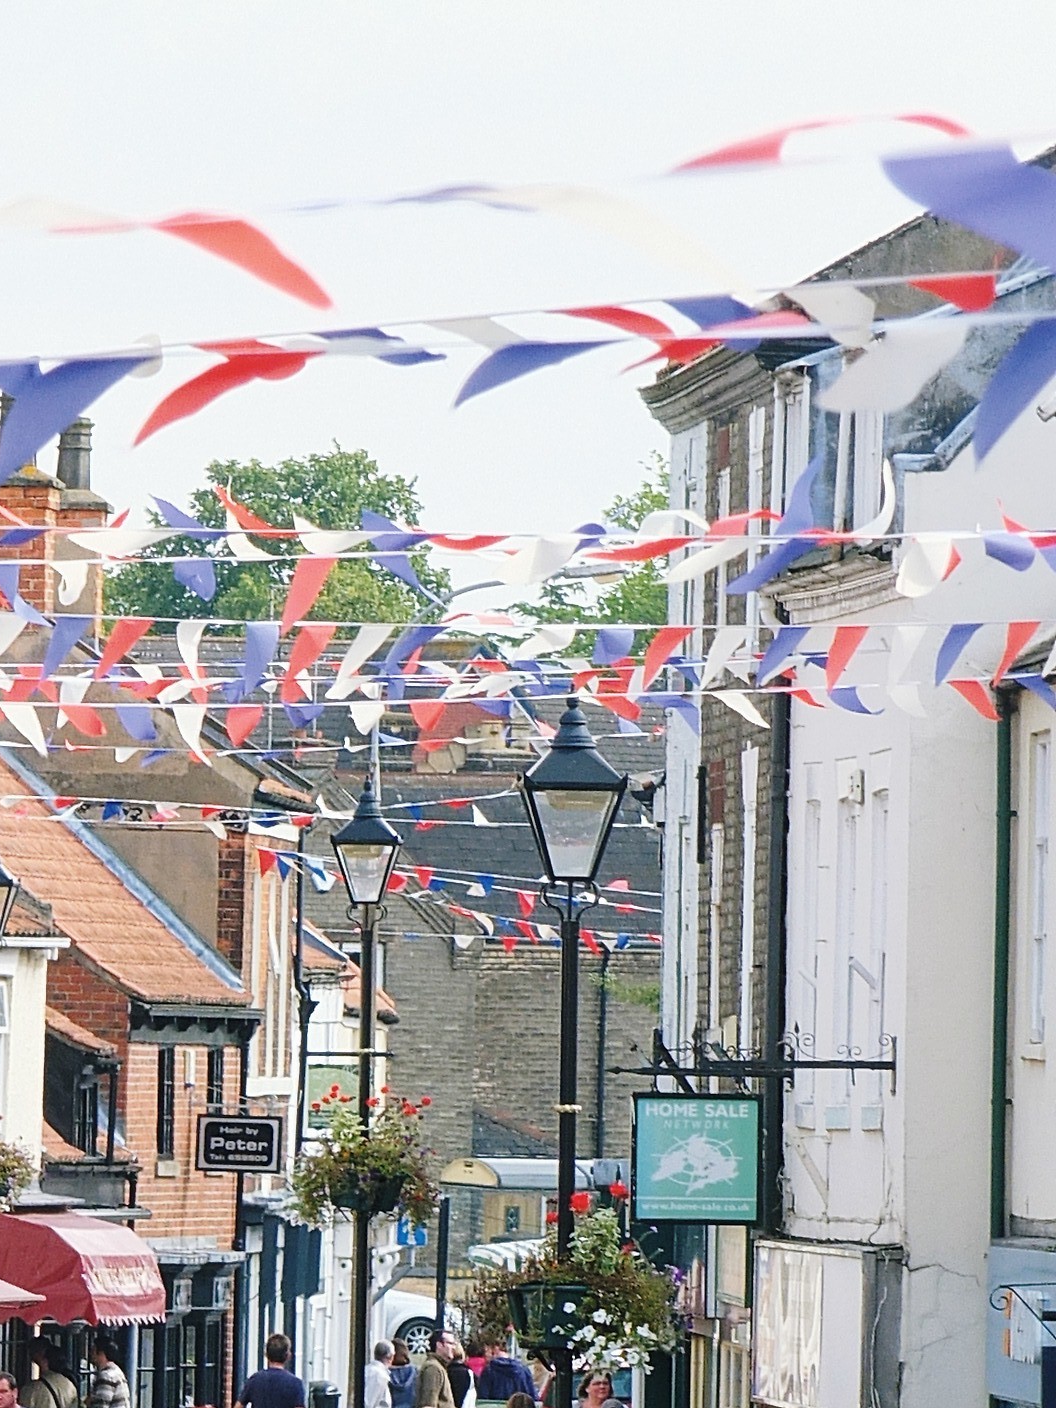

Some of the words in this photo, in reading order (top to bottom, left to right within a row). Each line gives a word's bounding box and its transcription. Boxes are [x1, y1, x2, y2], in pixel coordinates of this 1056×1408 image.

[645, 1103, 698, 1117] HOME
[704, 1103, 749, 1118] SALE
[219, 1126, 243, 1134] Hair
[245, 1127, 259, 1136] by
[663, 1119, 729, 1130] NETWORK
[210, 1136, 269, 1152] Peter
